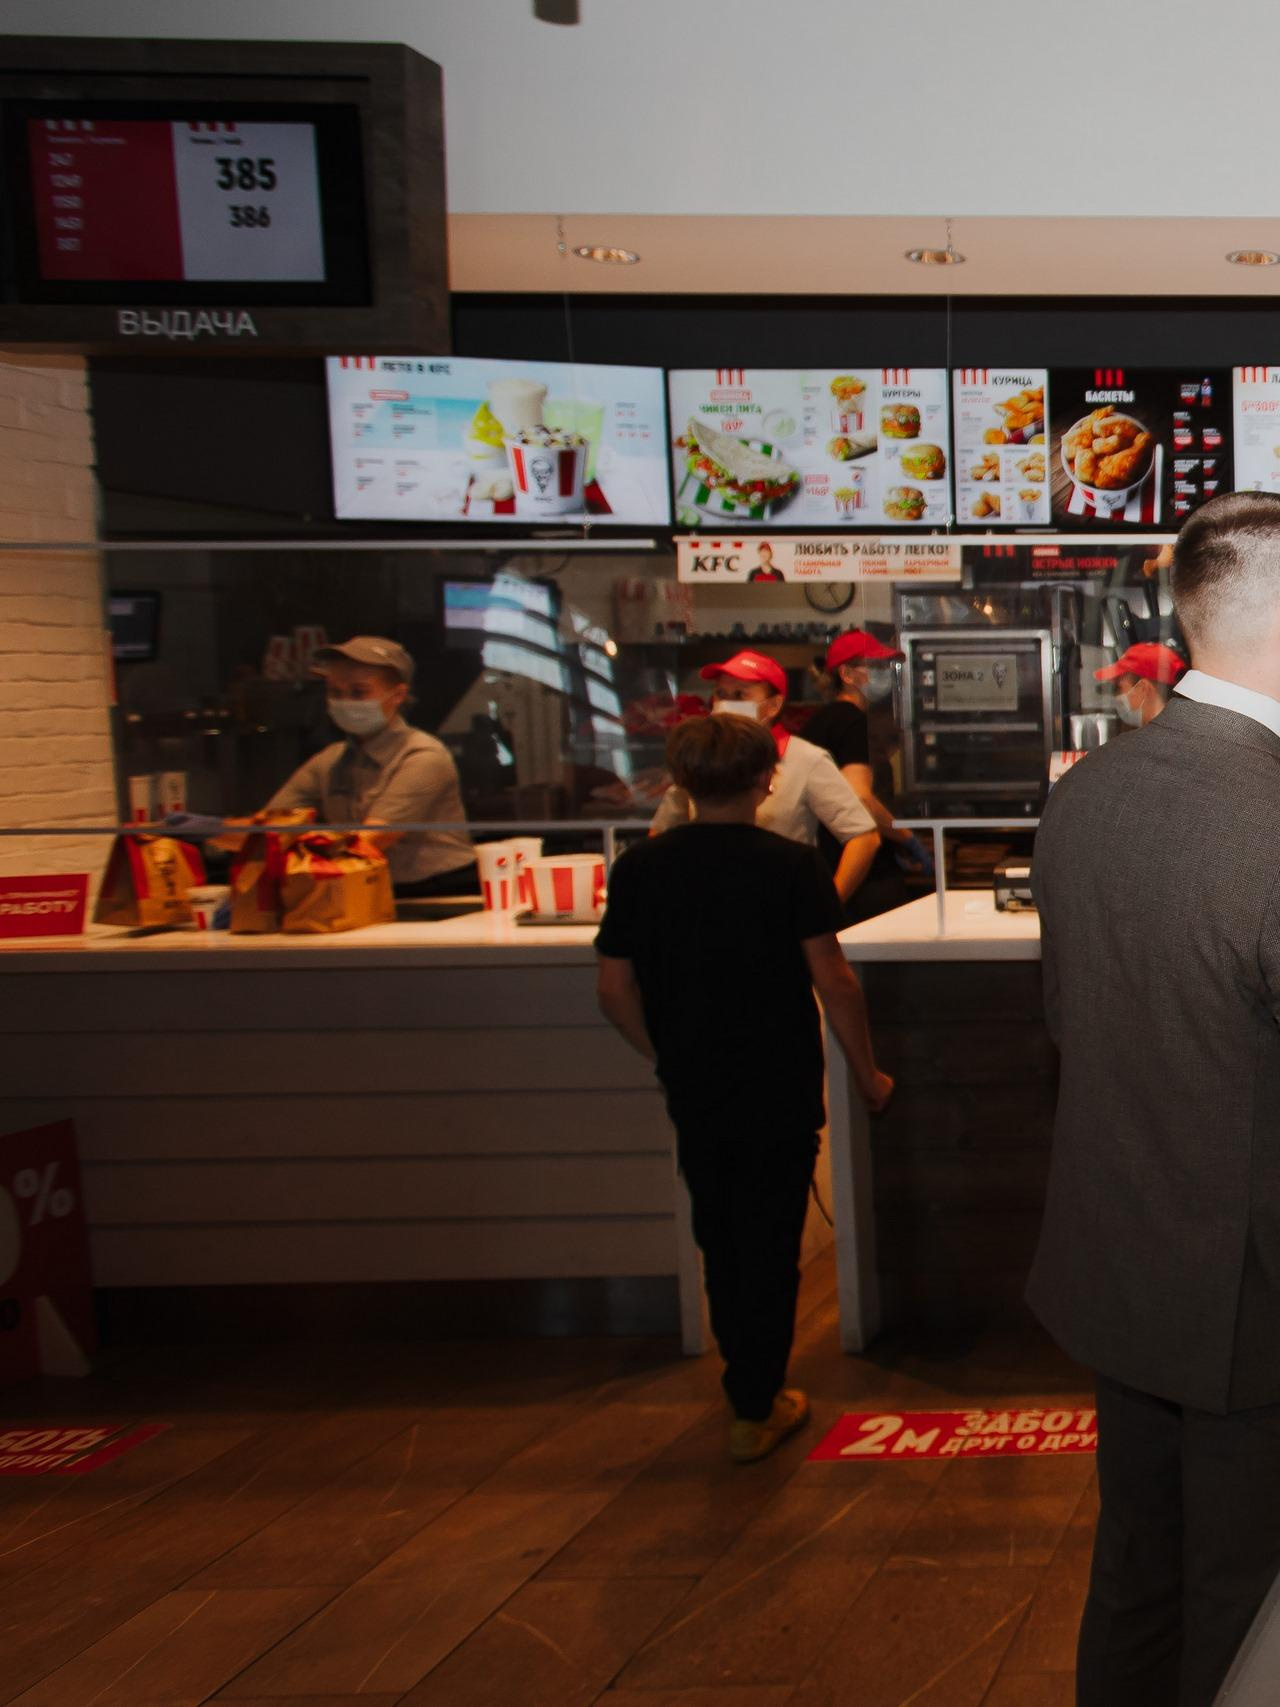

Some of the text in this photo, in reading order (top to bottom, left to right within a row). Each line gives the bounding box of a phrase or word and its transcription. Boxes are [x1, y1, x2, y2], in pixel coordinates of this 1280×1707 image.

[215, 157, 277, 191] 385
[227, 204, 271, 228] 386
[118, 310, 258, 340] ВЫДАЧА
[992, 375, 1033, 387] КУРИЦА
[882, 389, 921, 398] БУРГЕРЫ
[1085, 390, 1135, 403] БАСКЕТЫ
[794, 543, 950, 556] ЛЮБИТЬ РАБОТУ ЛЕГКО!
[690, 555, 740, 573] KFC
[942, 671, 985, 681] ЗОНА 2
[0, 900, 80, 916] РАБОТУ
[955, 1410, 1096, 1436] ЗАБОТ
[938, 1433, 1098, 1455] ДРУГ О ДРУ
